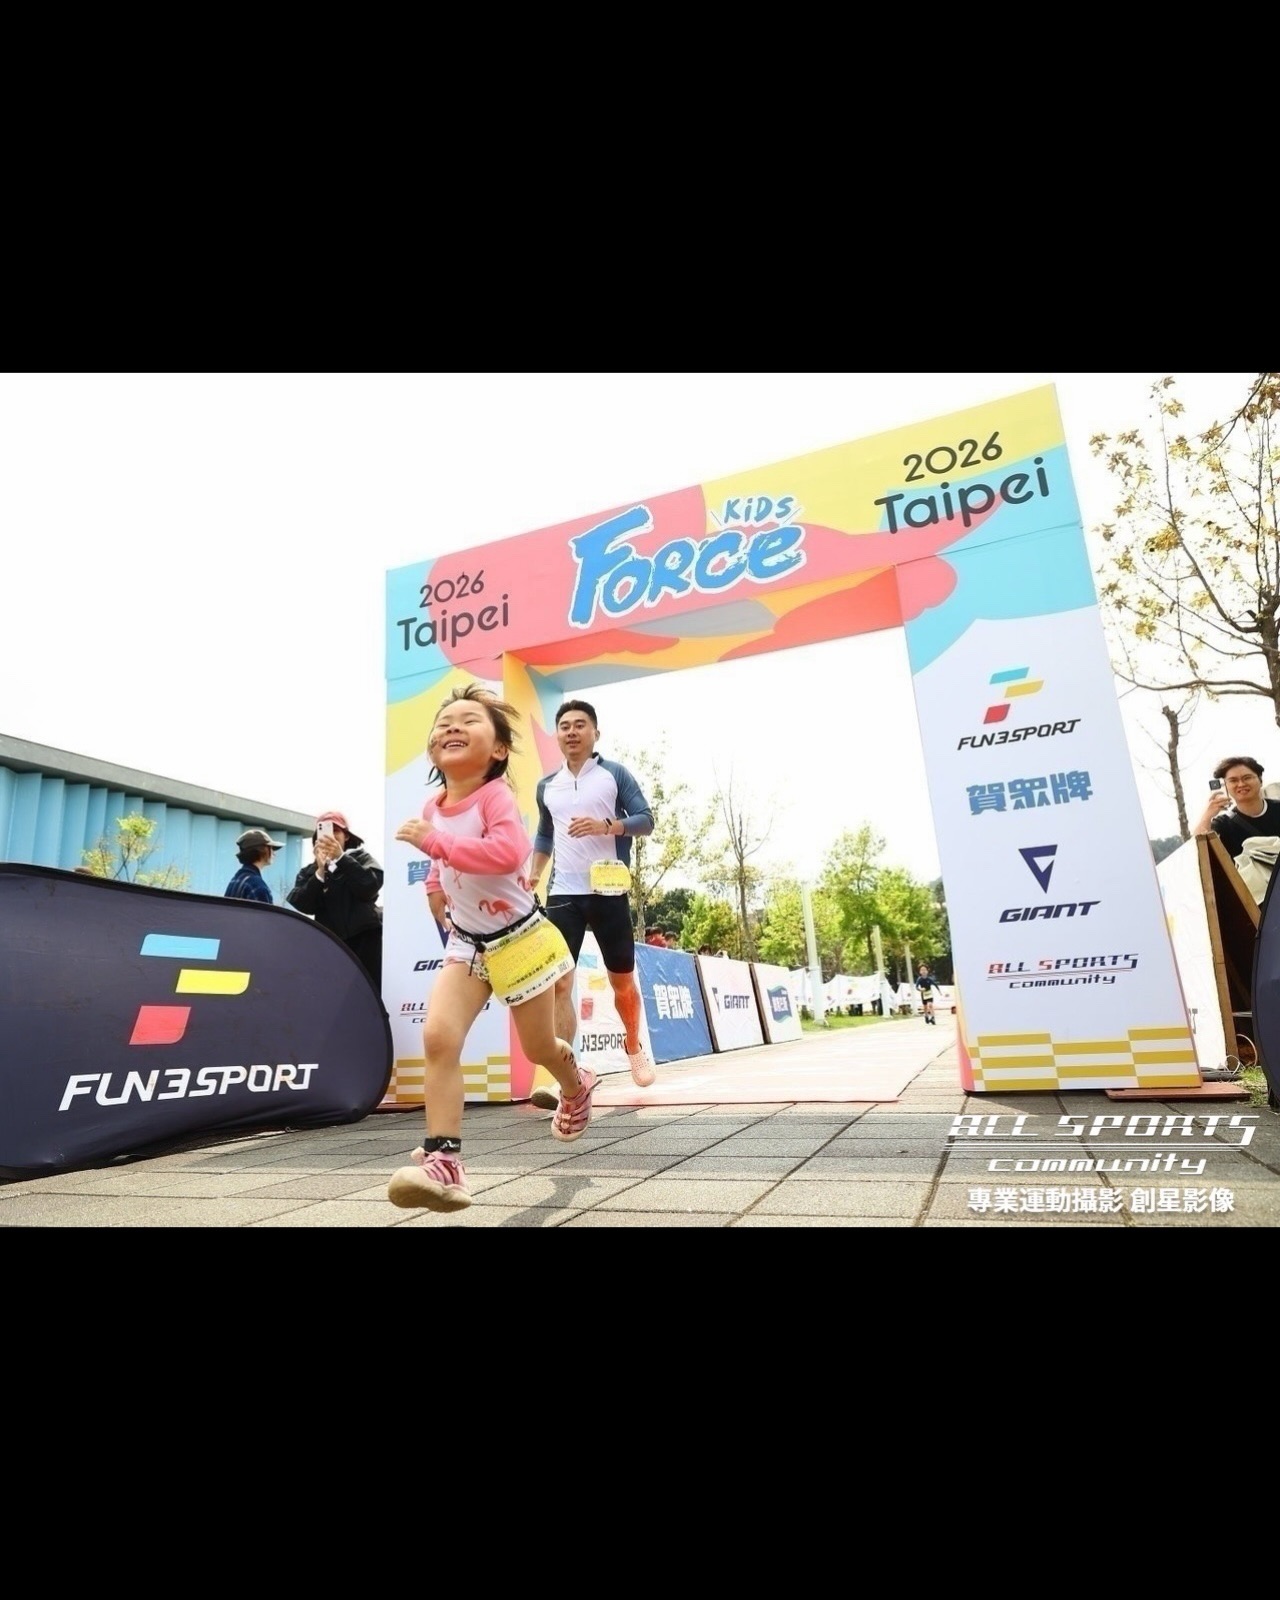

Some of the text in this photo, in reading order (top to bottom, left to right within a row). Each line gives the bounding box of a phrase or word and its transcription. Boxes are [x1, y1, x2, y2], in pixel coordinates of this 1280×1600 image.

[903, 431, 1003, 482] 2026
[874, 457, 1049, 534] Taipei
[419, 569, 485, 609] 2026
[397, 594, 509, 652] Taipei
[957, 718, 1081, 751] FUN3SPORT
[966, 770, 1093, 815] 賀眾牌
[999, 900, 1101, 923] GIANT
[988, 953, 1139, 975] ALL SPORTS
[1009, 974, 1116, 989] community
[723, 994, 750, 1010] GIANT
[58, 1063, 319, 1112] FUN3SPORT
